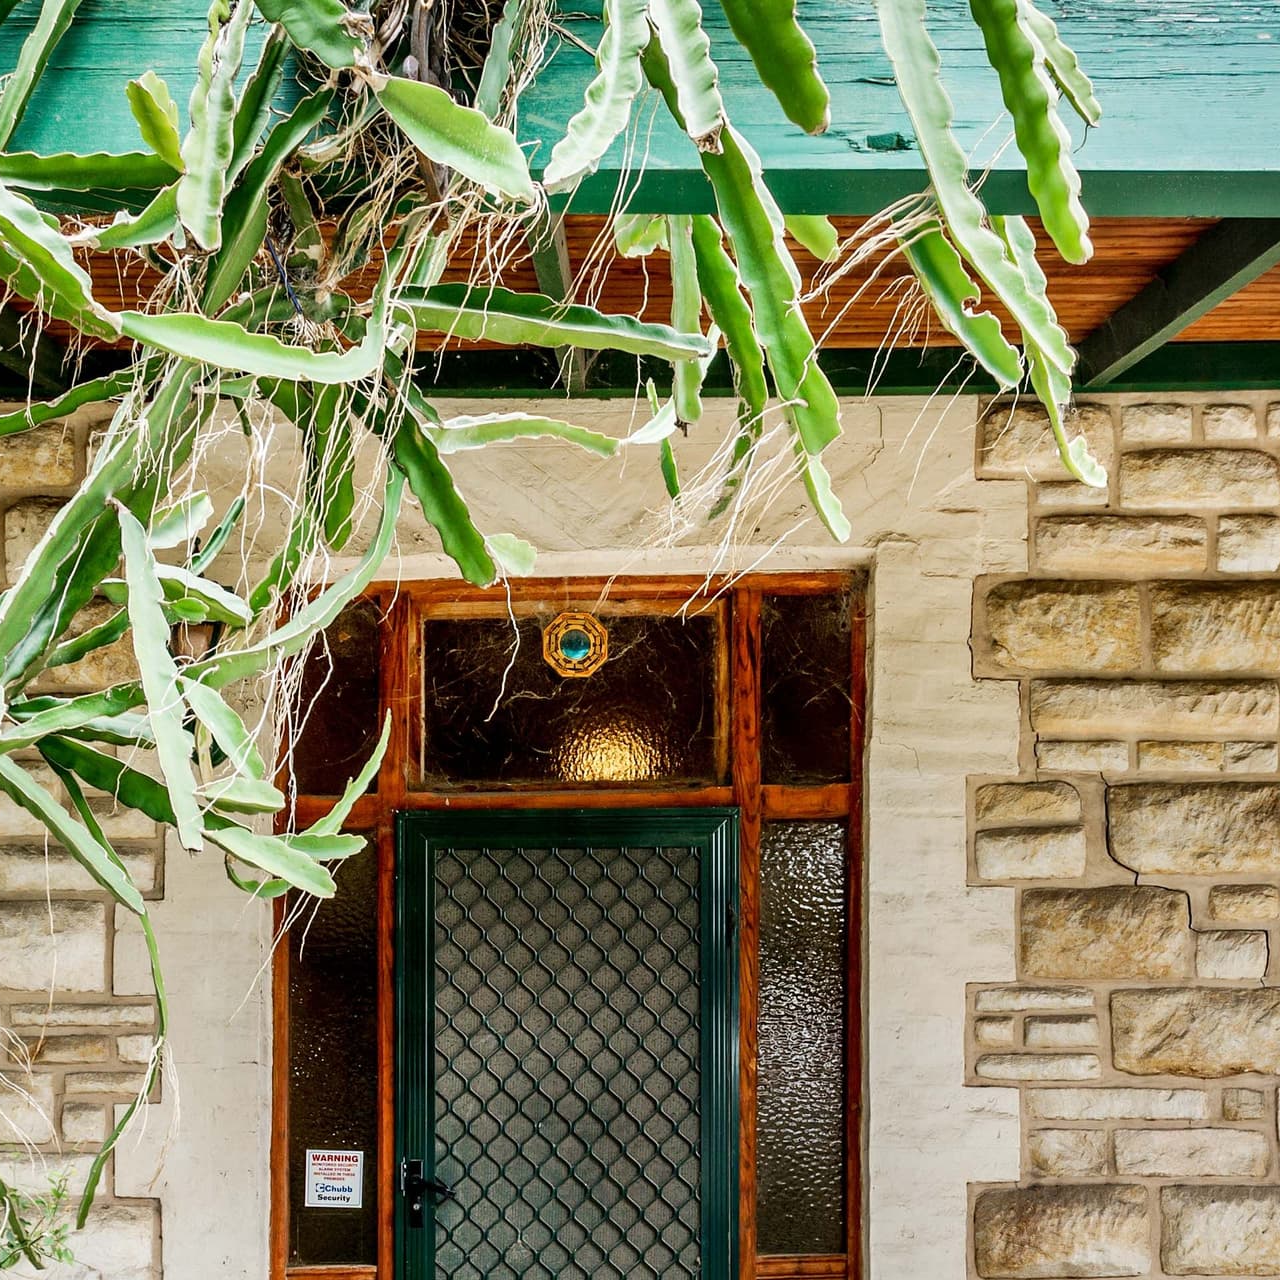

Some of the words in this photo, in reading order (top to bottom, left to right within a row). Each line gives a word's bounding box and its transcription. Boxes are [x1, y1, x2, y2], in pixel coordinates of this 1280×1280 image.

[312, 1154, 359, 1163] WARNING
[325, 1185, 353, 1193] Chubb
[317, 1194, 351, 1203] Security
